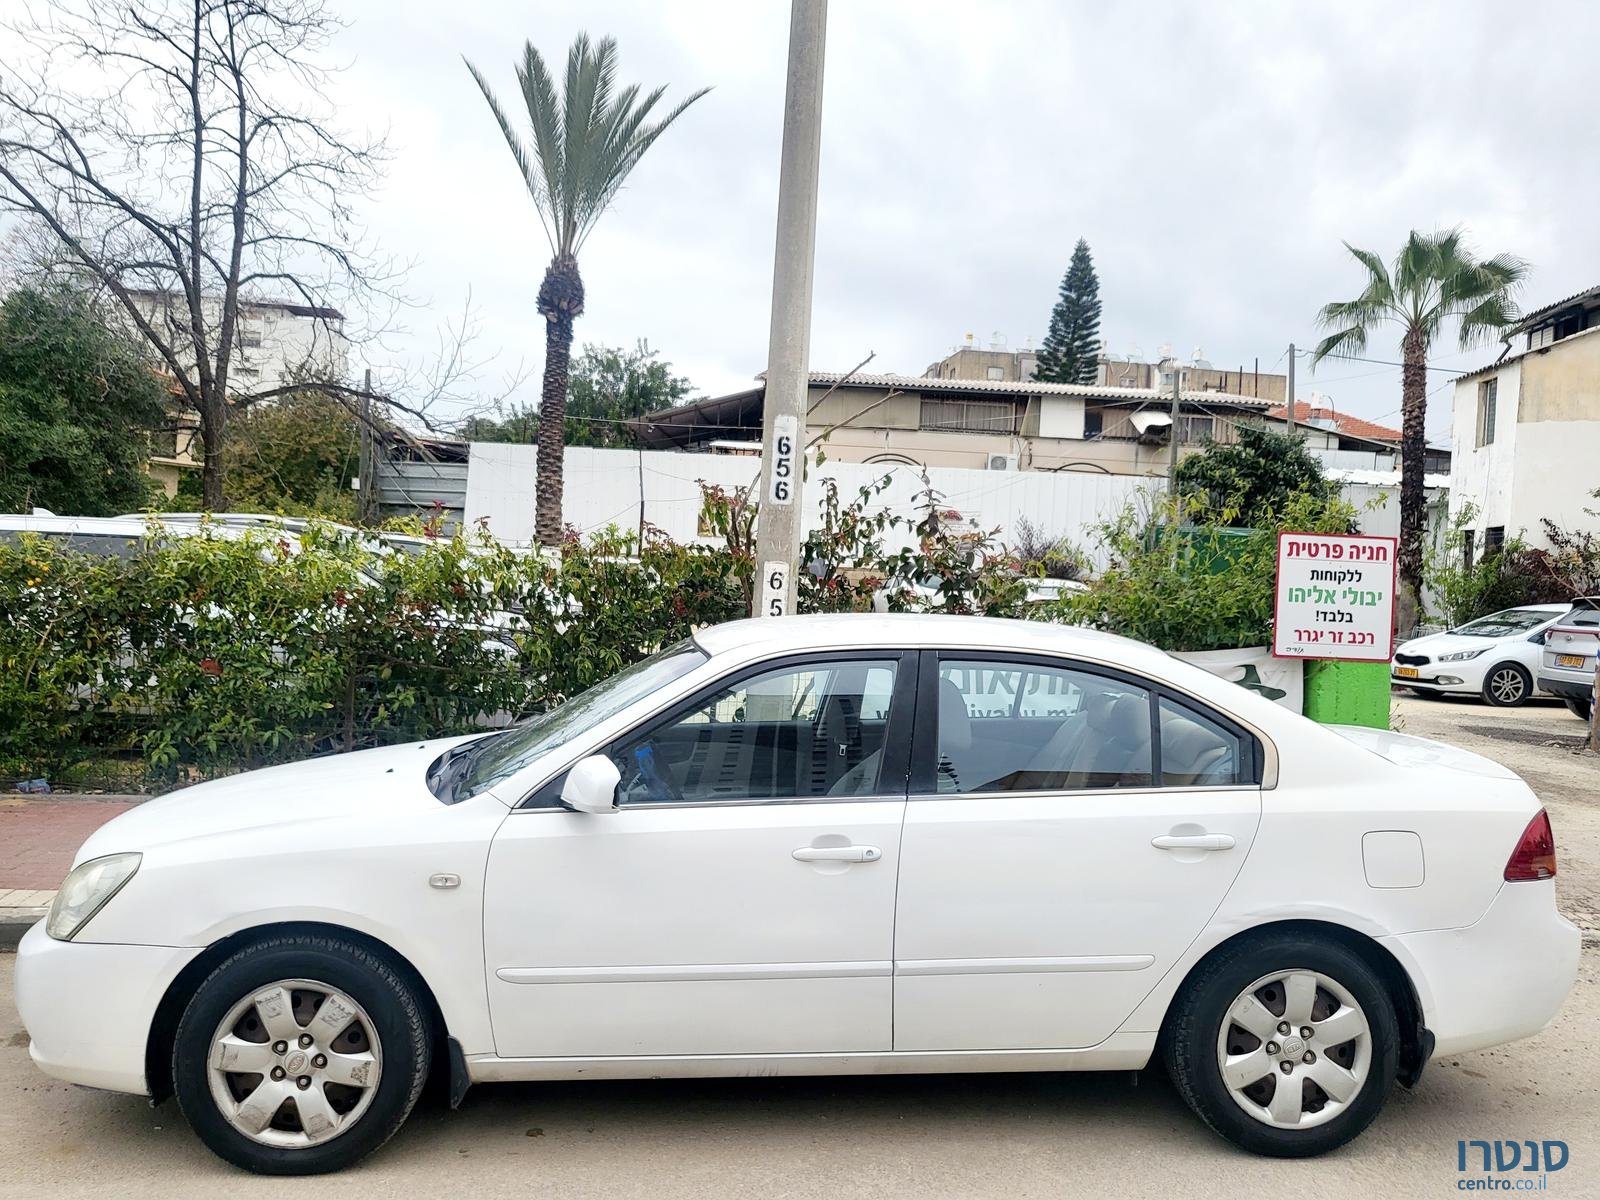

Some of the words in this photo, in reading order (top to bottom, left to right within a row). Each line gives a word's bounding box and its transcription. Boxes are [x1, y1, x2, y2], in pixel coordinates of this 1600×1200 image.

[775, 436, 791, 501] 656
[1287, 541, 1344, 559] פרטית
[1349, 544, 1388, 561] חניה
[1310, 569, 1362, 585] ללקוחות
[1288, 586, 1337, 605] אליהו
[1342, 587, 1383, 606] יבולי
[1316, 610, 1354, 623] בלבד!
[1294, 629, 1324, 642] יגרר
[1328, 630, 1344, 643] זר
[1347, 631, 1375, 644] רכב
